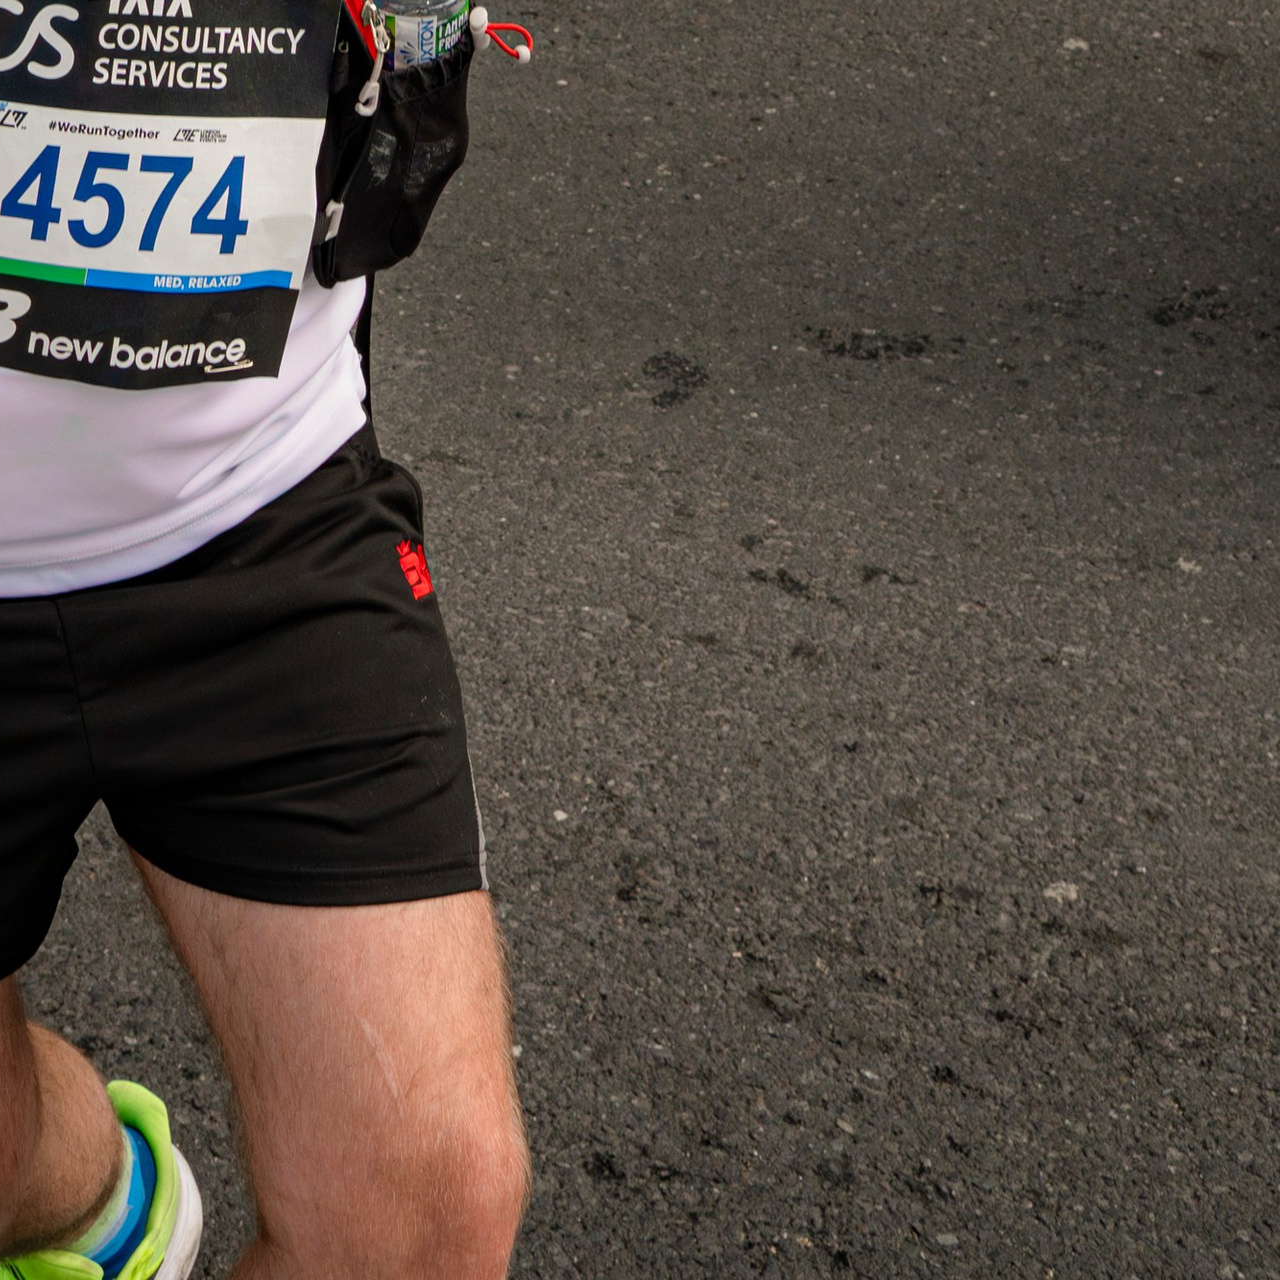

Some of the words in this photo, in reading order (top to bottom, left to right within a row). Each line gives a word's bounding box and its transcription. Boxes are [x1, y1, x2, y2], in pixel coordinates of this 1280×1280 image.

[98, 22, 306, 55] CONSULTANCY
[92, 61, 228, 90] SERVICES
[48, 120, 161, 141] #WeRunTogether
[153, 274, 185, 290] MED,
[188, 274, 242, 290] RELAXED
[27, 331, 100, 365] new
[109, 336, 247, 372] balance
